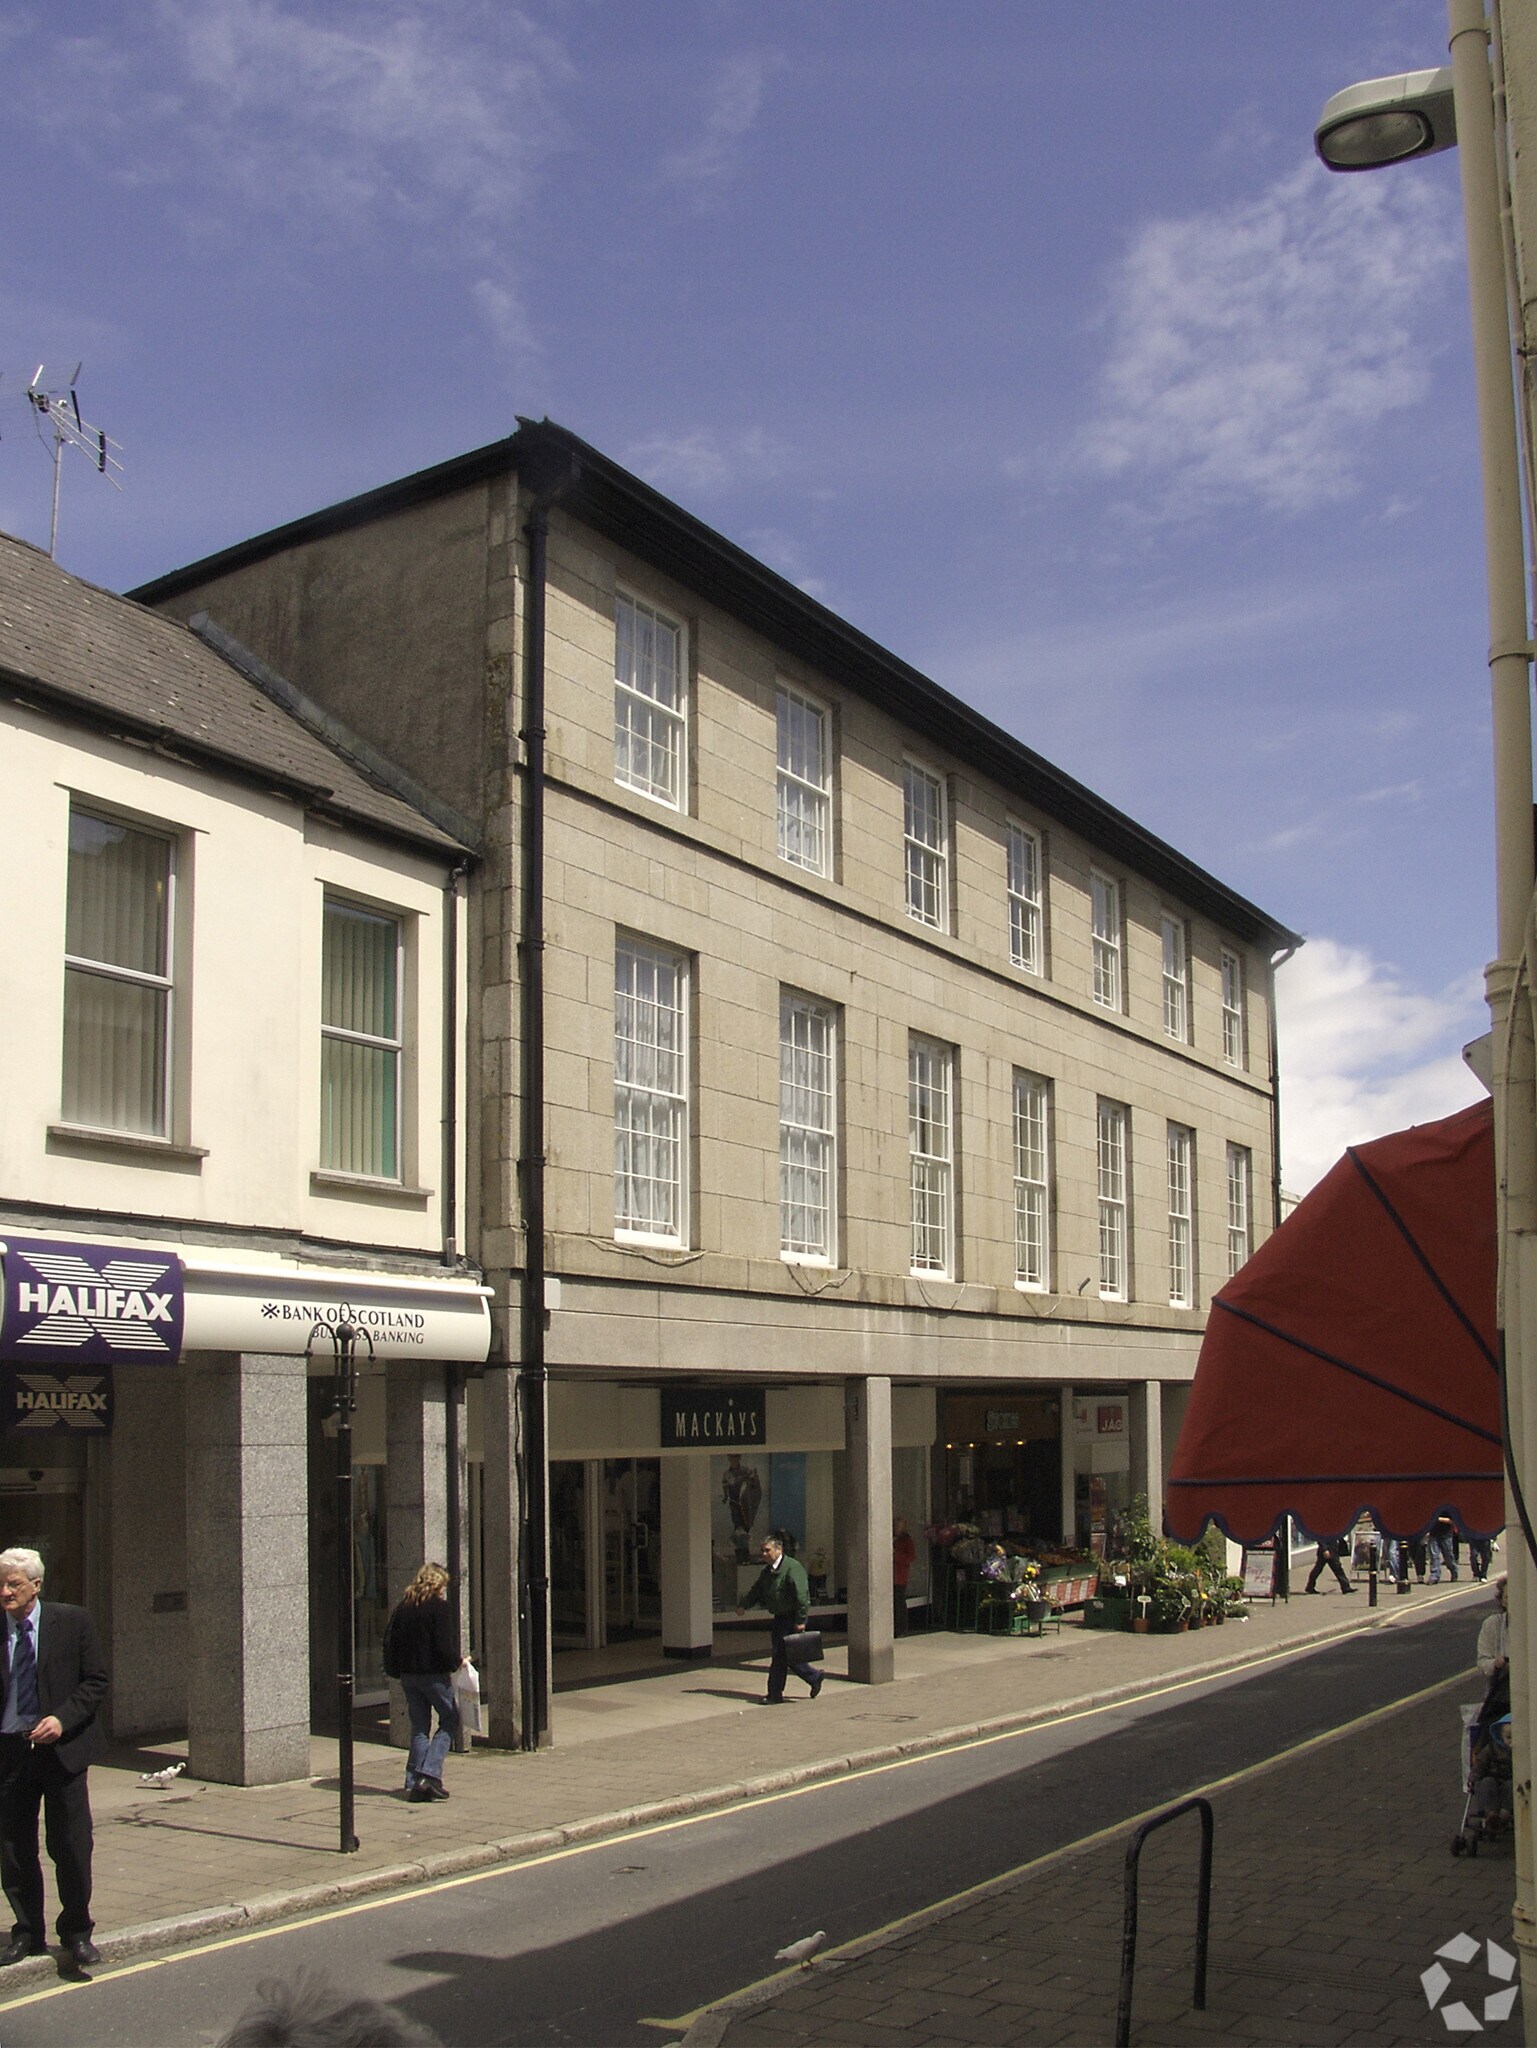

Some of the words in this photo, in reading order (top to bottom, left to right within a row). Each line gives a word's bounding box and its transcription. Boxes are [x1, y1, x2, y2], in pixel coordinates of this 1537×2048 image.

[18, 1282, 174, 1322] HALIFAX
[282, 1304, 324, 1322] BANK
[326, 1307, 348, 1323] OF
[349, 1308, 425, 1329] SCOTLAND
[311, 1327, 369, 1341] BUSSS
[372, 1330, 424, 1345] BANKING
[16, 1391, 108, 1410] HALIFAX
[675, 1411, 757, 1437] MACKAYS
